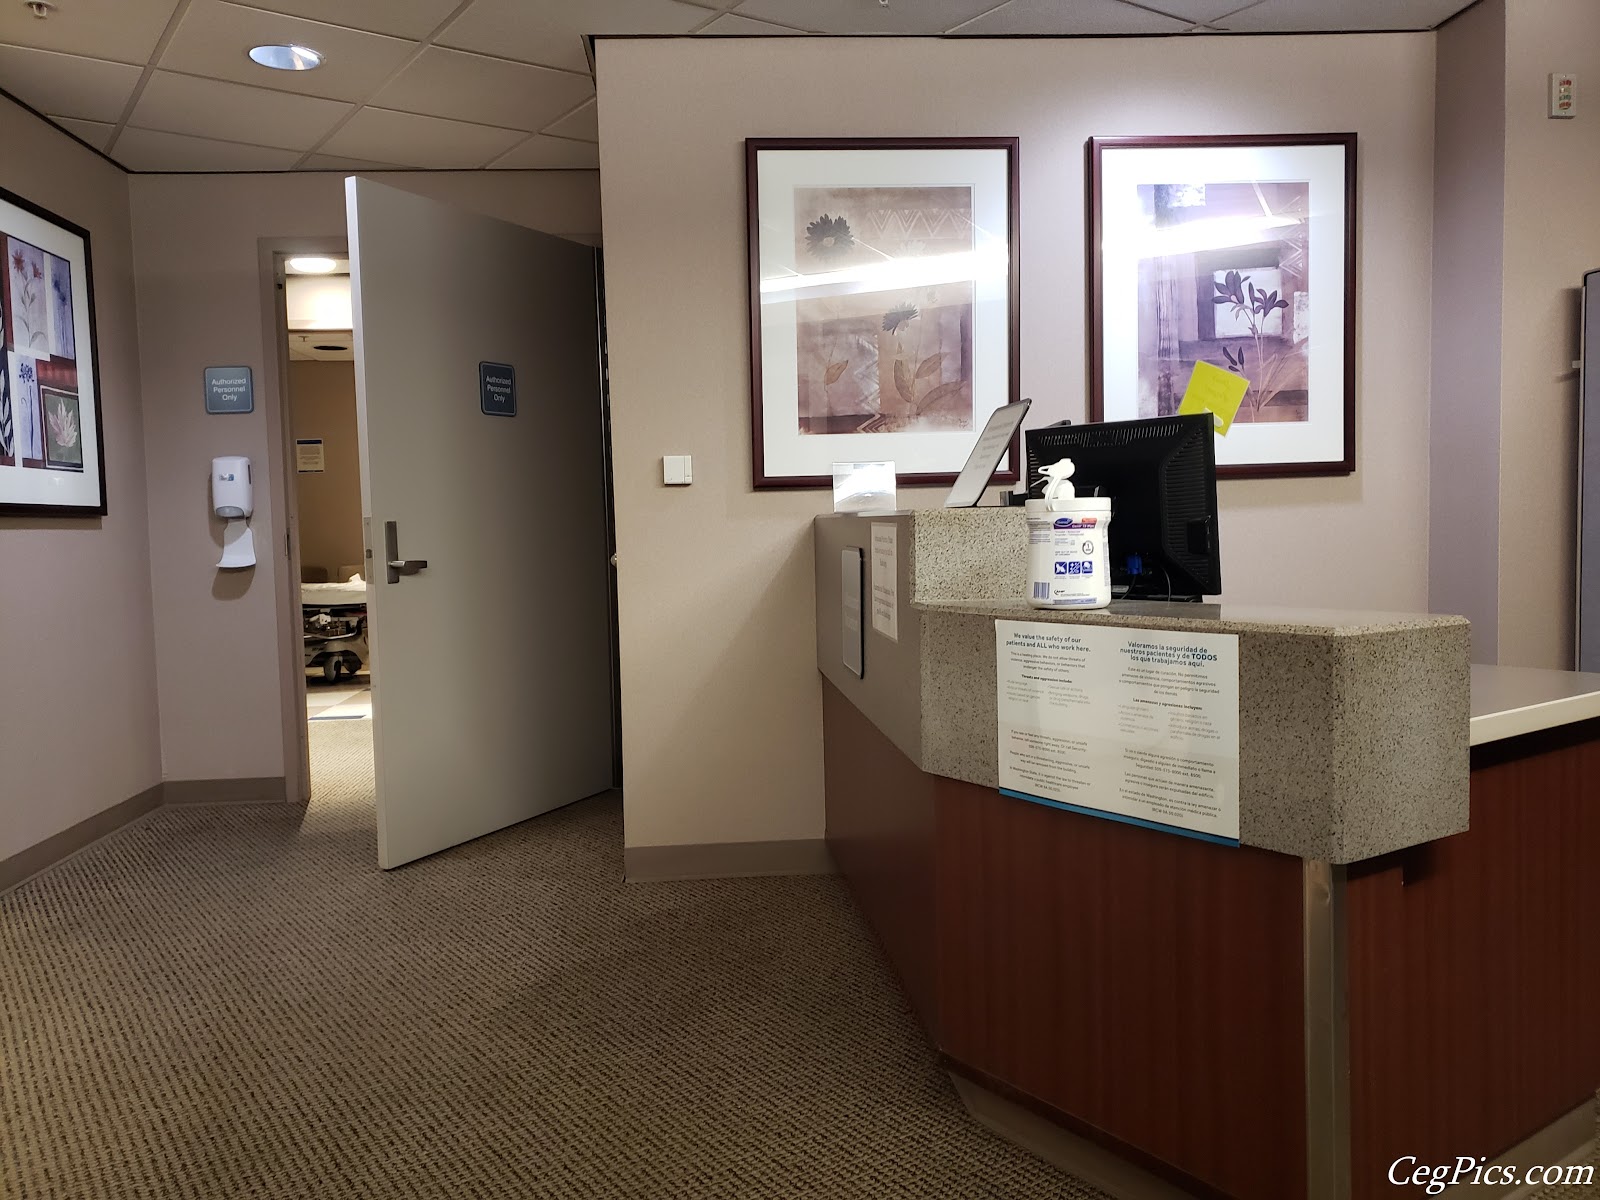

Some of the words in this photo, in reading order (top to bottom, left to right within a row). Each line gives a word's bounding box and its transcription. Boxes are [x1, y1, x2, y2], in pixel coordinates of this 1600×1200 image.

[486, 375, 511, 385] Authorized
[487, 384, 510, 393] Personnel
[494, 394, 505, 403] Only
[1046, 635, 1063, 644] safety
[1128, 641, 1159, 650] Valoramos
[1165, 645, 1198, 653] seguridad
[1147, 650, 1176, 658] pacientes
[1191, 653, 1218, 661] TODOS
[1151, 657, 1187, 666] trabajamos
